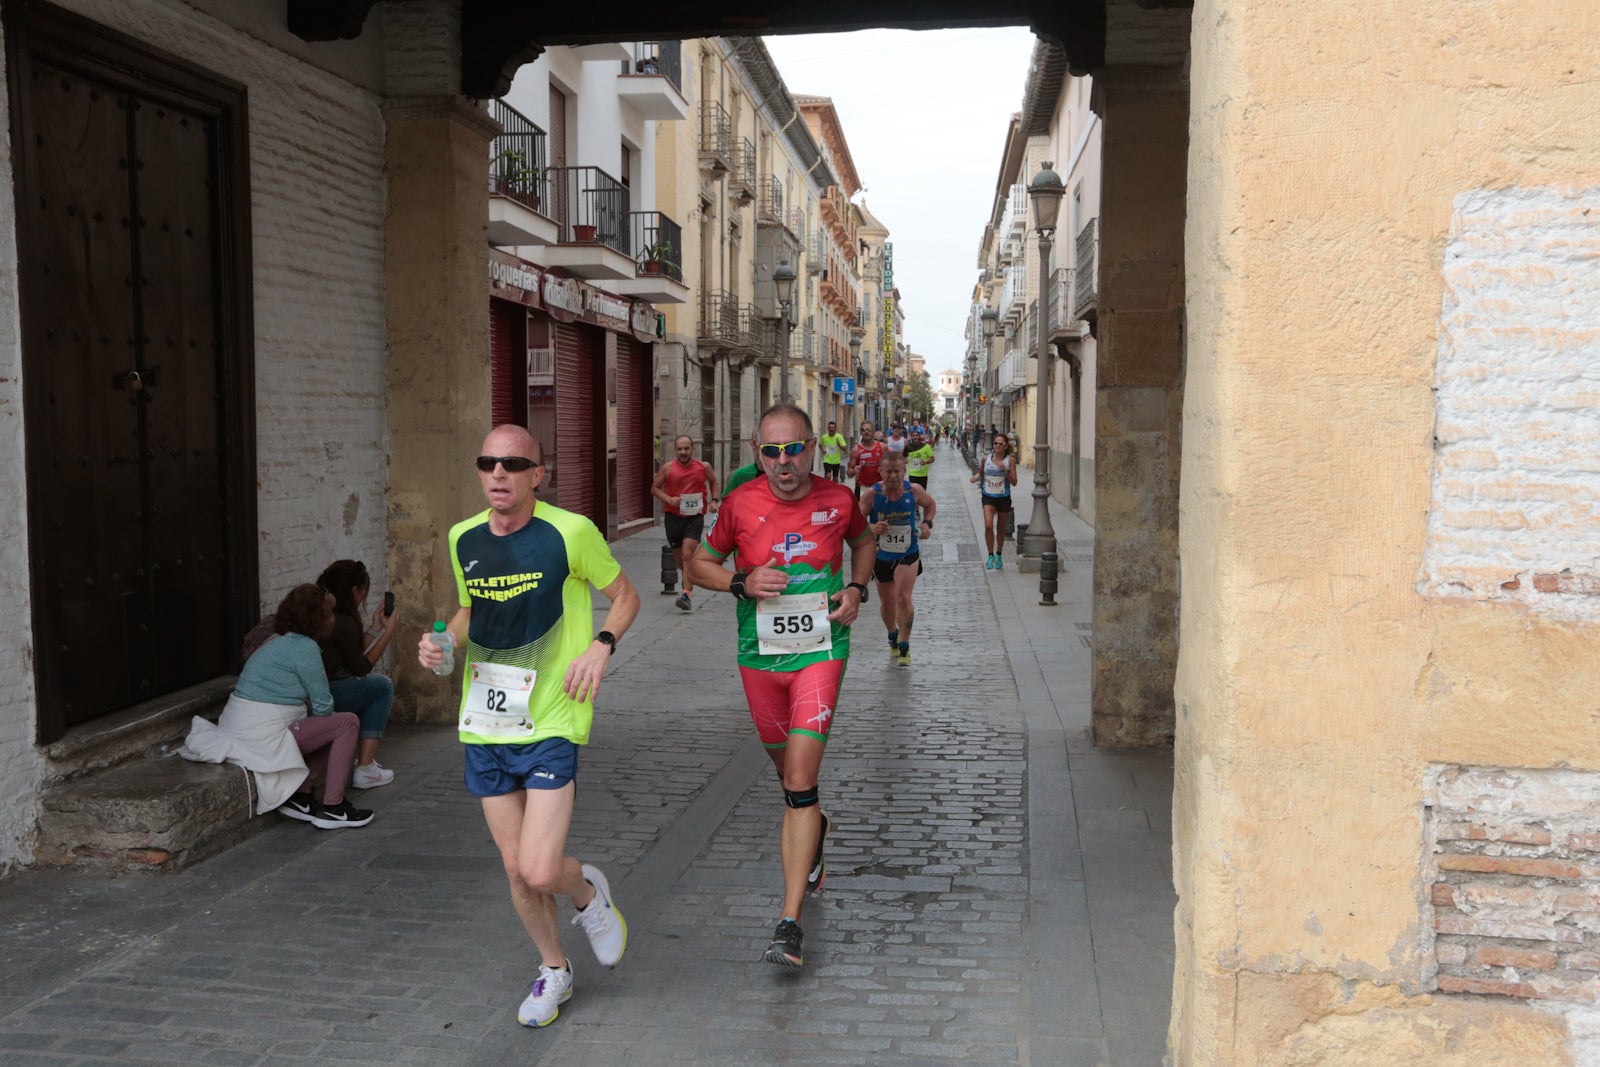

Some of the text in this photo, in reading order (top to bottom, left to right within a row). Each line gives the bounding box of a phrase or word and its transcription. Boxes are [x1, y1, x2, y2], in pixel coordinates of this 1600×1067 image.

[884, 242, 892, 290] TEJIDOS
[884, 299, 892, 377] CONFECCION
[685, 500, 699, 508] 525
[886, 534, 905, 543] 314
[465, 571, 543, 588] ATLETISMO
[468, 581, 539, 602] ALHENDÍN
[773, 614, 814, 634] 559
[487, 688, 507, 713] 82
